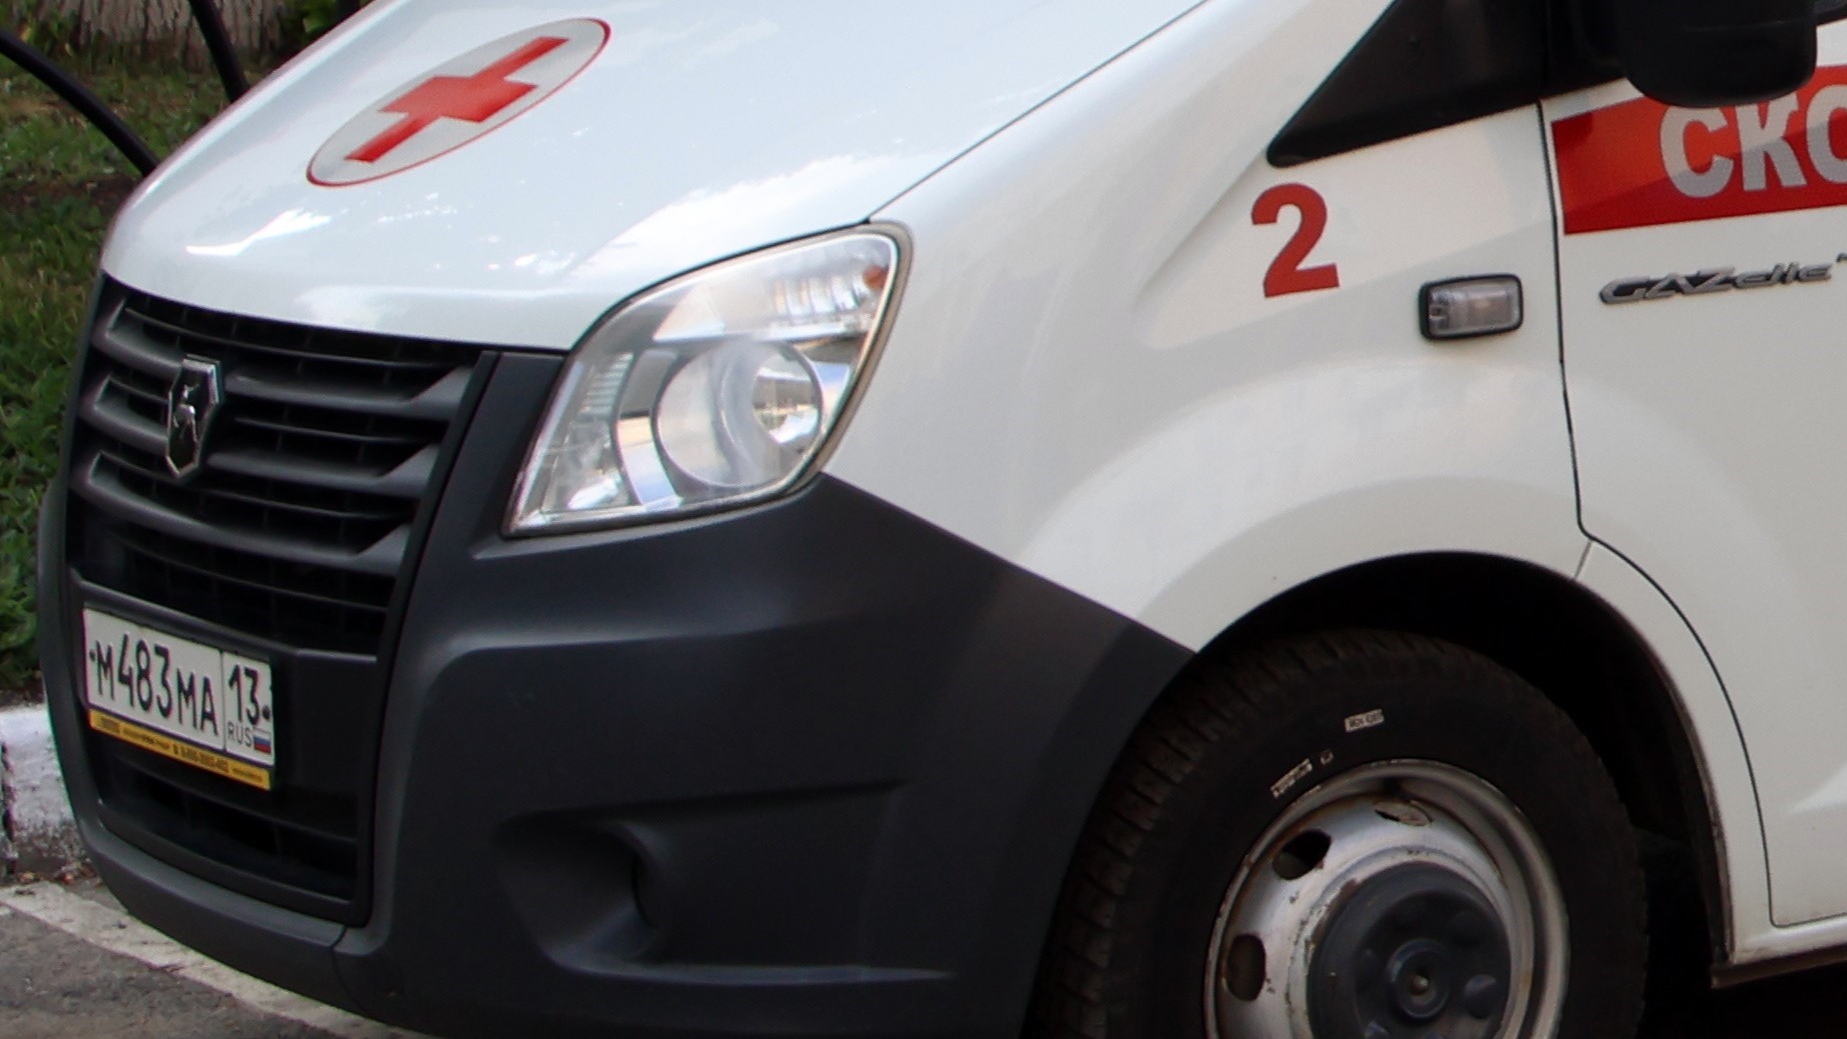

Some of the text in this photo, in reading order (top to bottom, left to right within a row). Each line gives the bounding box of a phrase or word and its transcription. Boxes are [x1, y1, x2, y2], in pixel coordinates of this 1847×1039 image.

[1250, 182, 1340, 299] 2
[95, 632, 261, 736] М483МА 13
[226, 721, 253, 748] RUS
